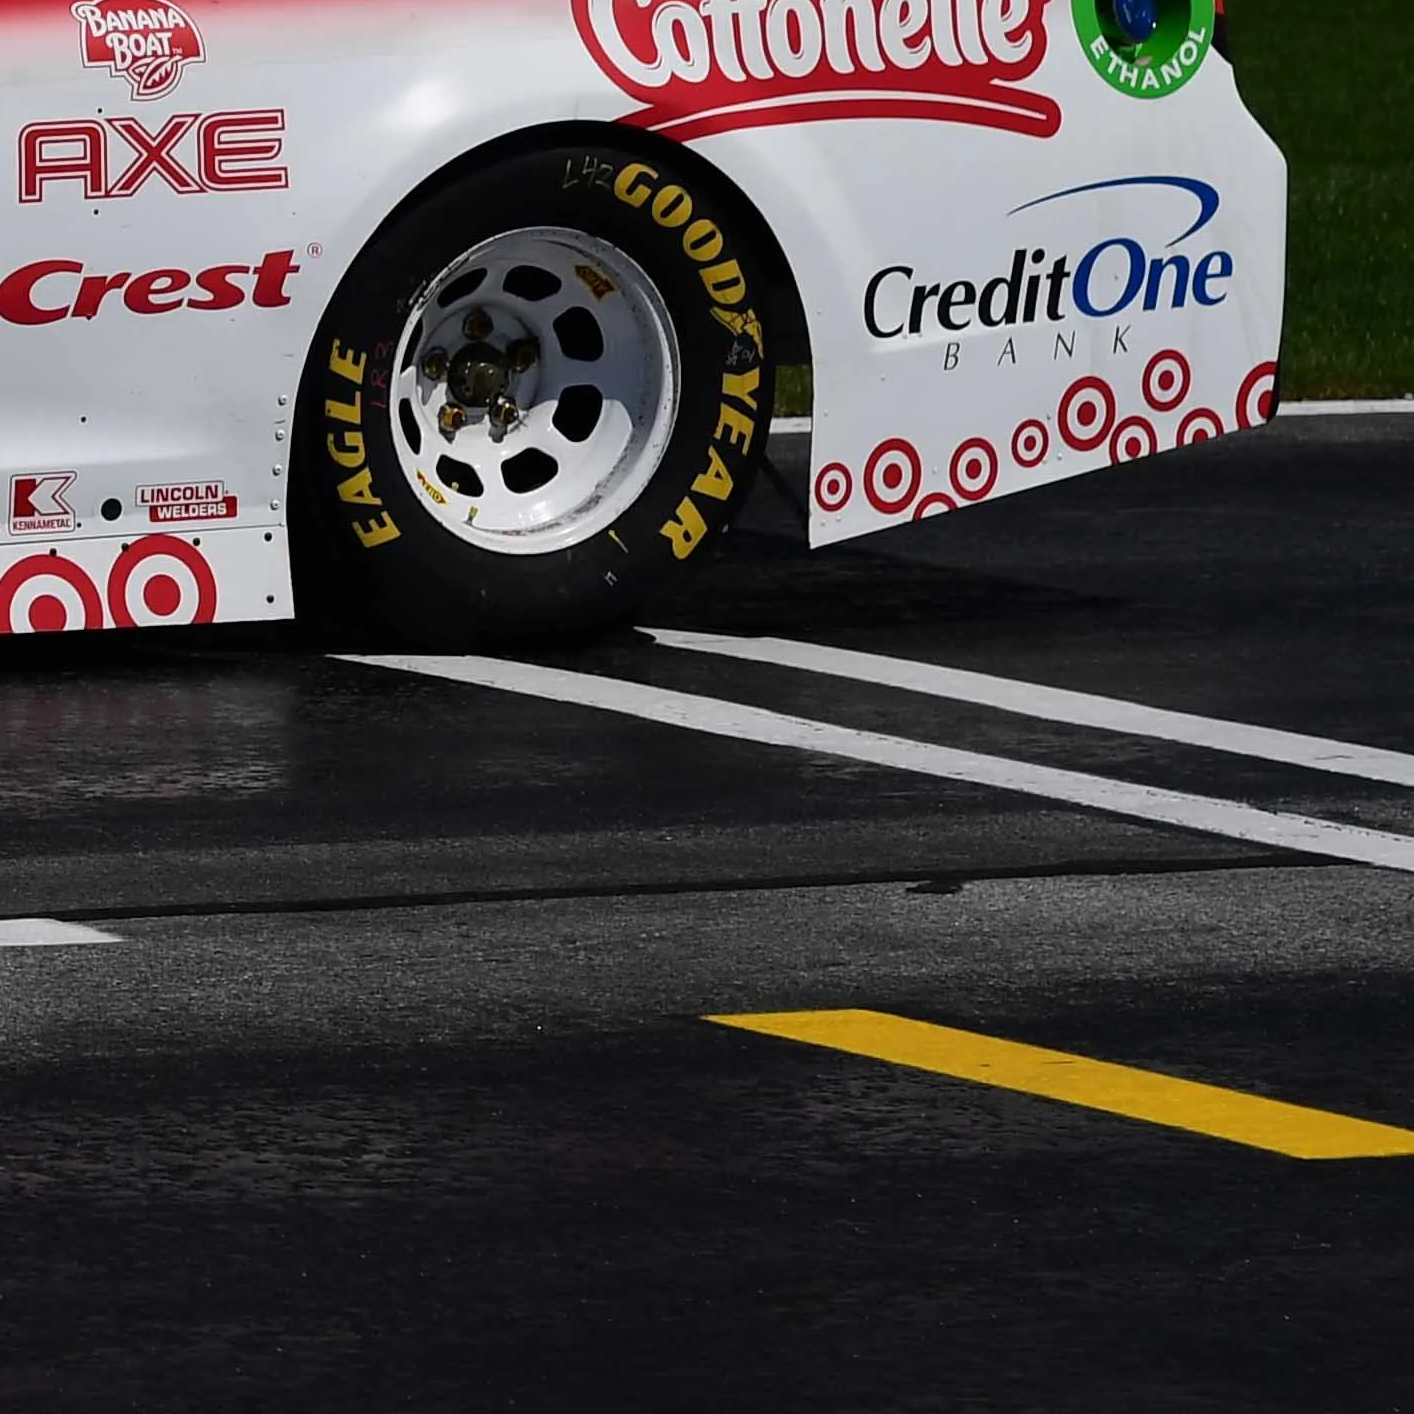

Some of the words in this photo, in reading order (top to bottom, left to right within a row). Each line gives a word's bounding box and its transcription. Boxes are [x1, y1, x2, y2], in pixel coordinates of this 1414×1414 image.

[80, 1, 186, 38] BANANA
[105, 30, 173, 72] BOAT
[1089, 26, 1206, 91] ETHANOL
[18, 107, 290, 204] AXE
[612, 161, 765, 562] GOODYEAR
[942, 324, 1133, 372] BANK
[324, 337, 402, 549] EAGLE
[140, 483, 220, 504] LINCOLN
[156, 502, 228, 520] WELDERS
[12, 517, 72, 532] KENNAMETAL
